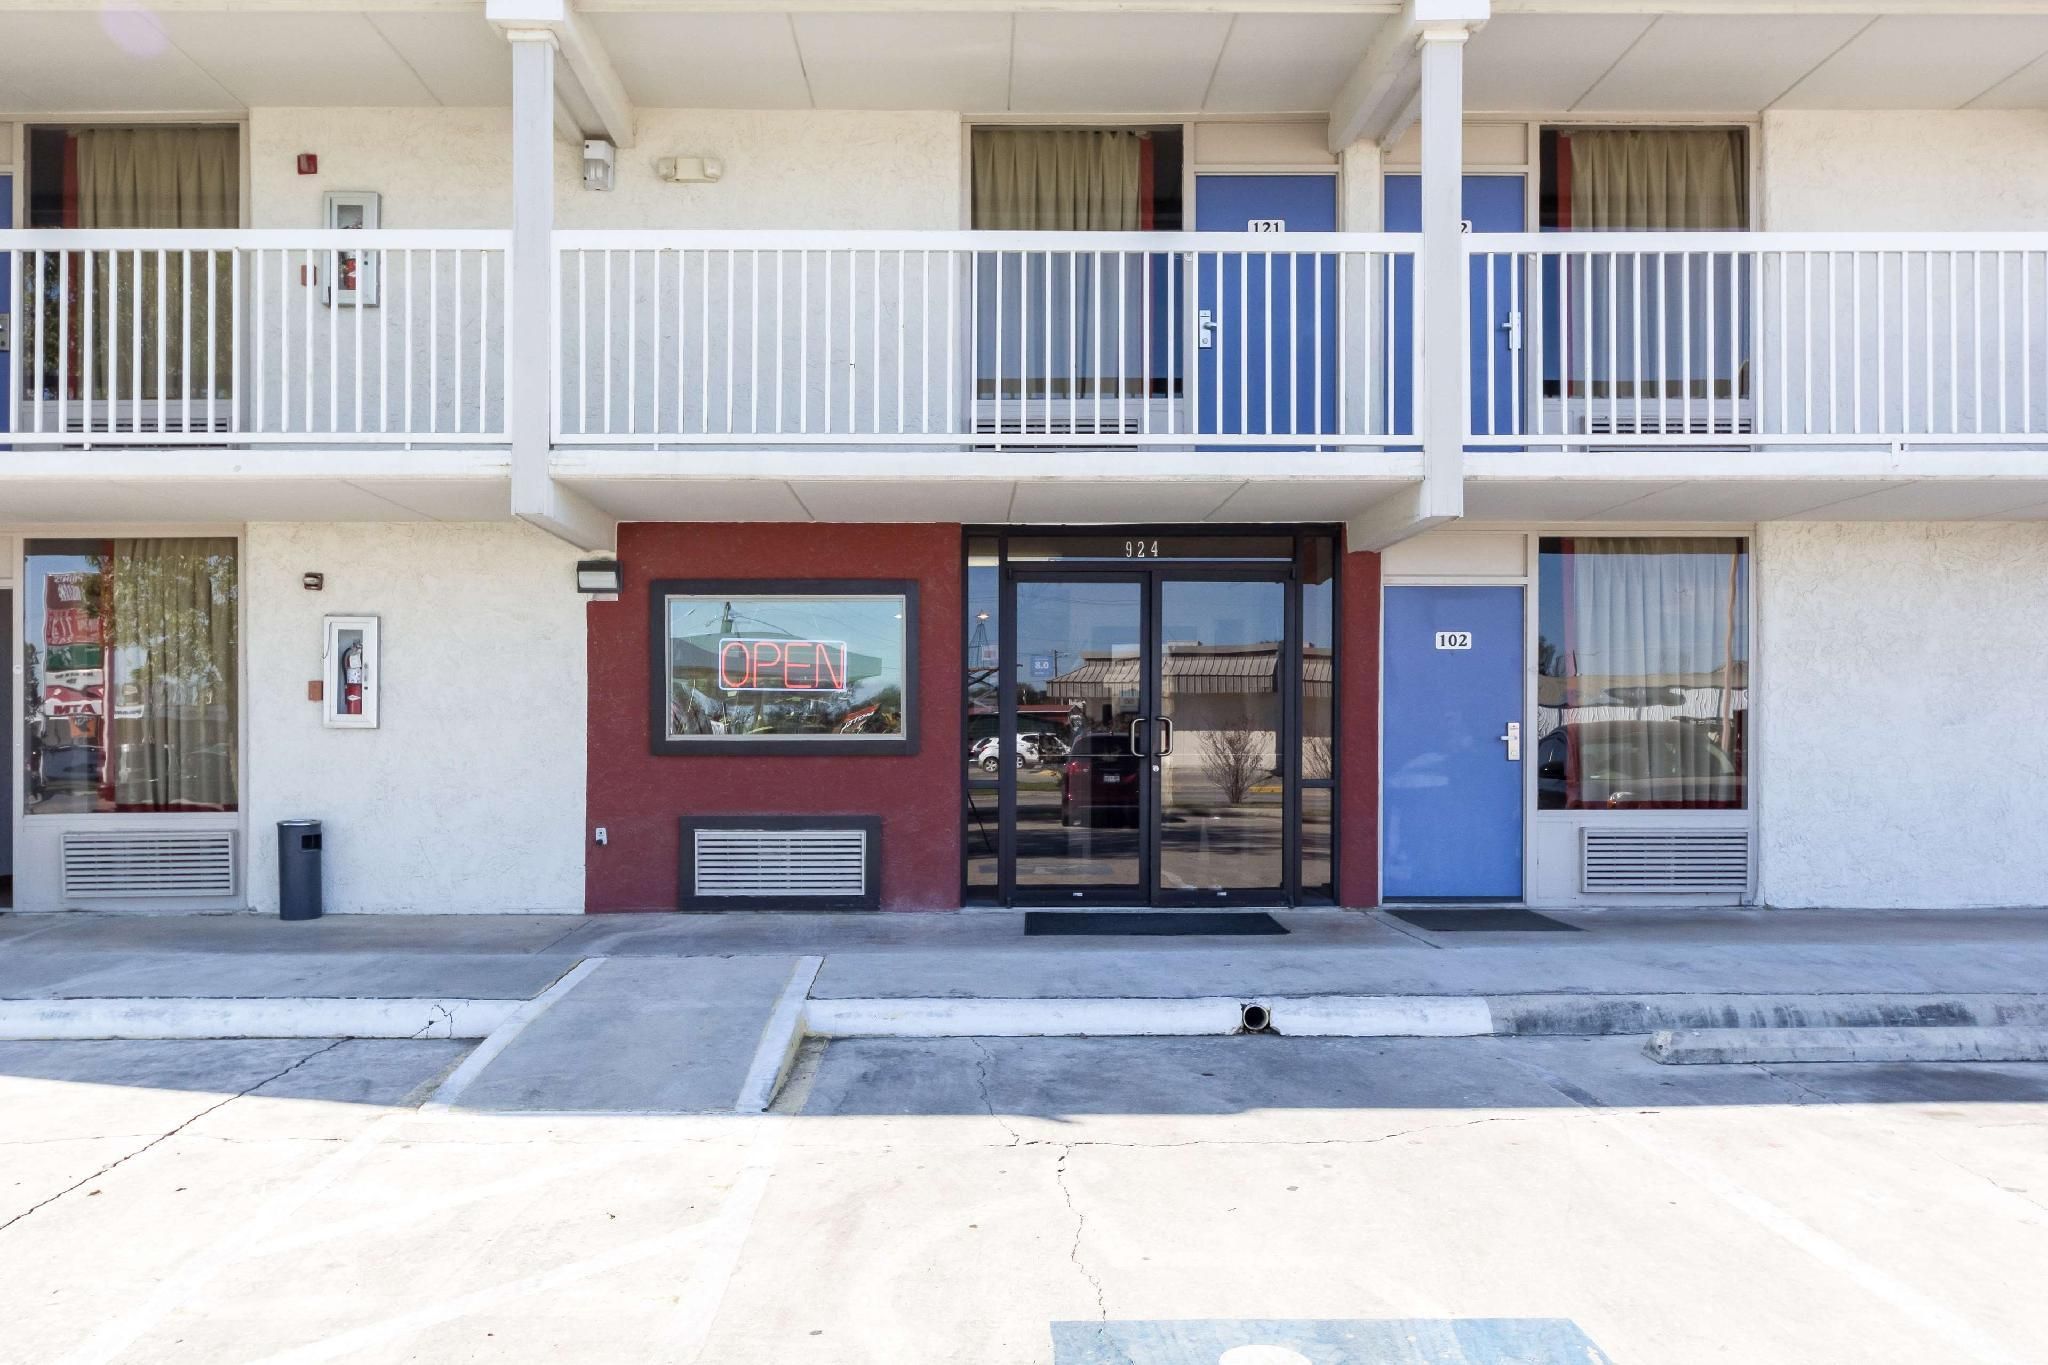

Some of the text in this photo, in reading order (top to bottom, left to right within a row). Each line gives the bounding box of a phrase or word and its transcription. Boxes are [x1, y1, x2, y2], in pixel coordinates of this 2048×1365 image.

[1253, 222, 1280, 232] 121
[1126, 540, 1158, 557] 924
[1439, 634, 1468, 647] 102
[721, 641, 844, 689] OPEN
